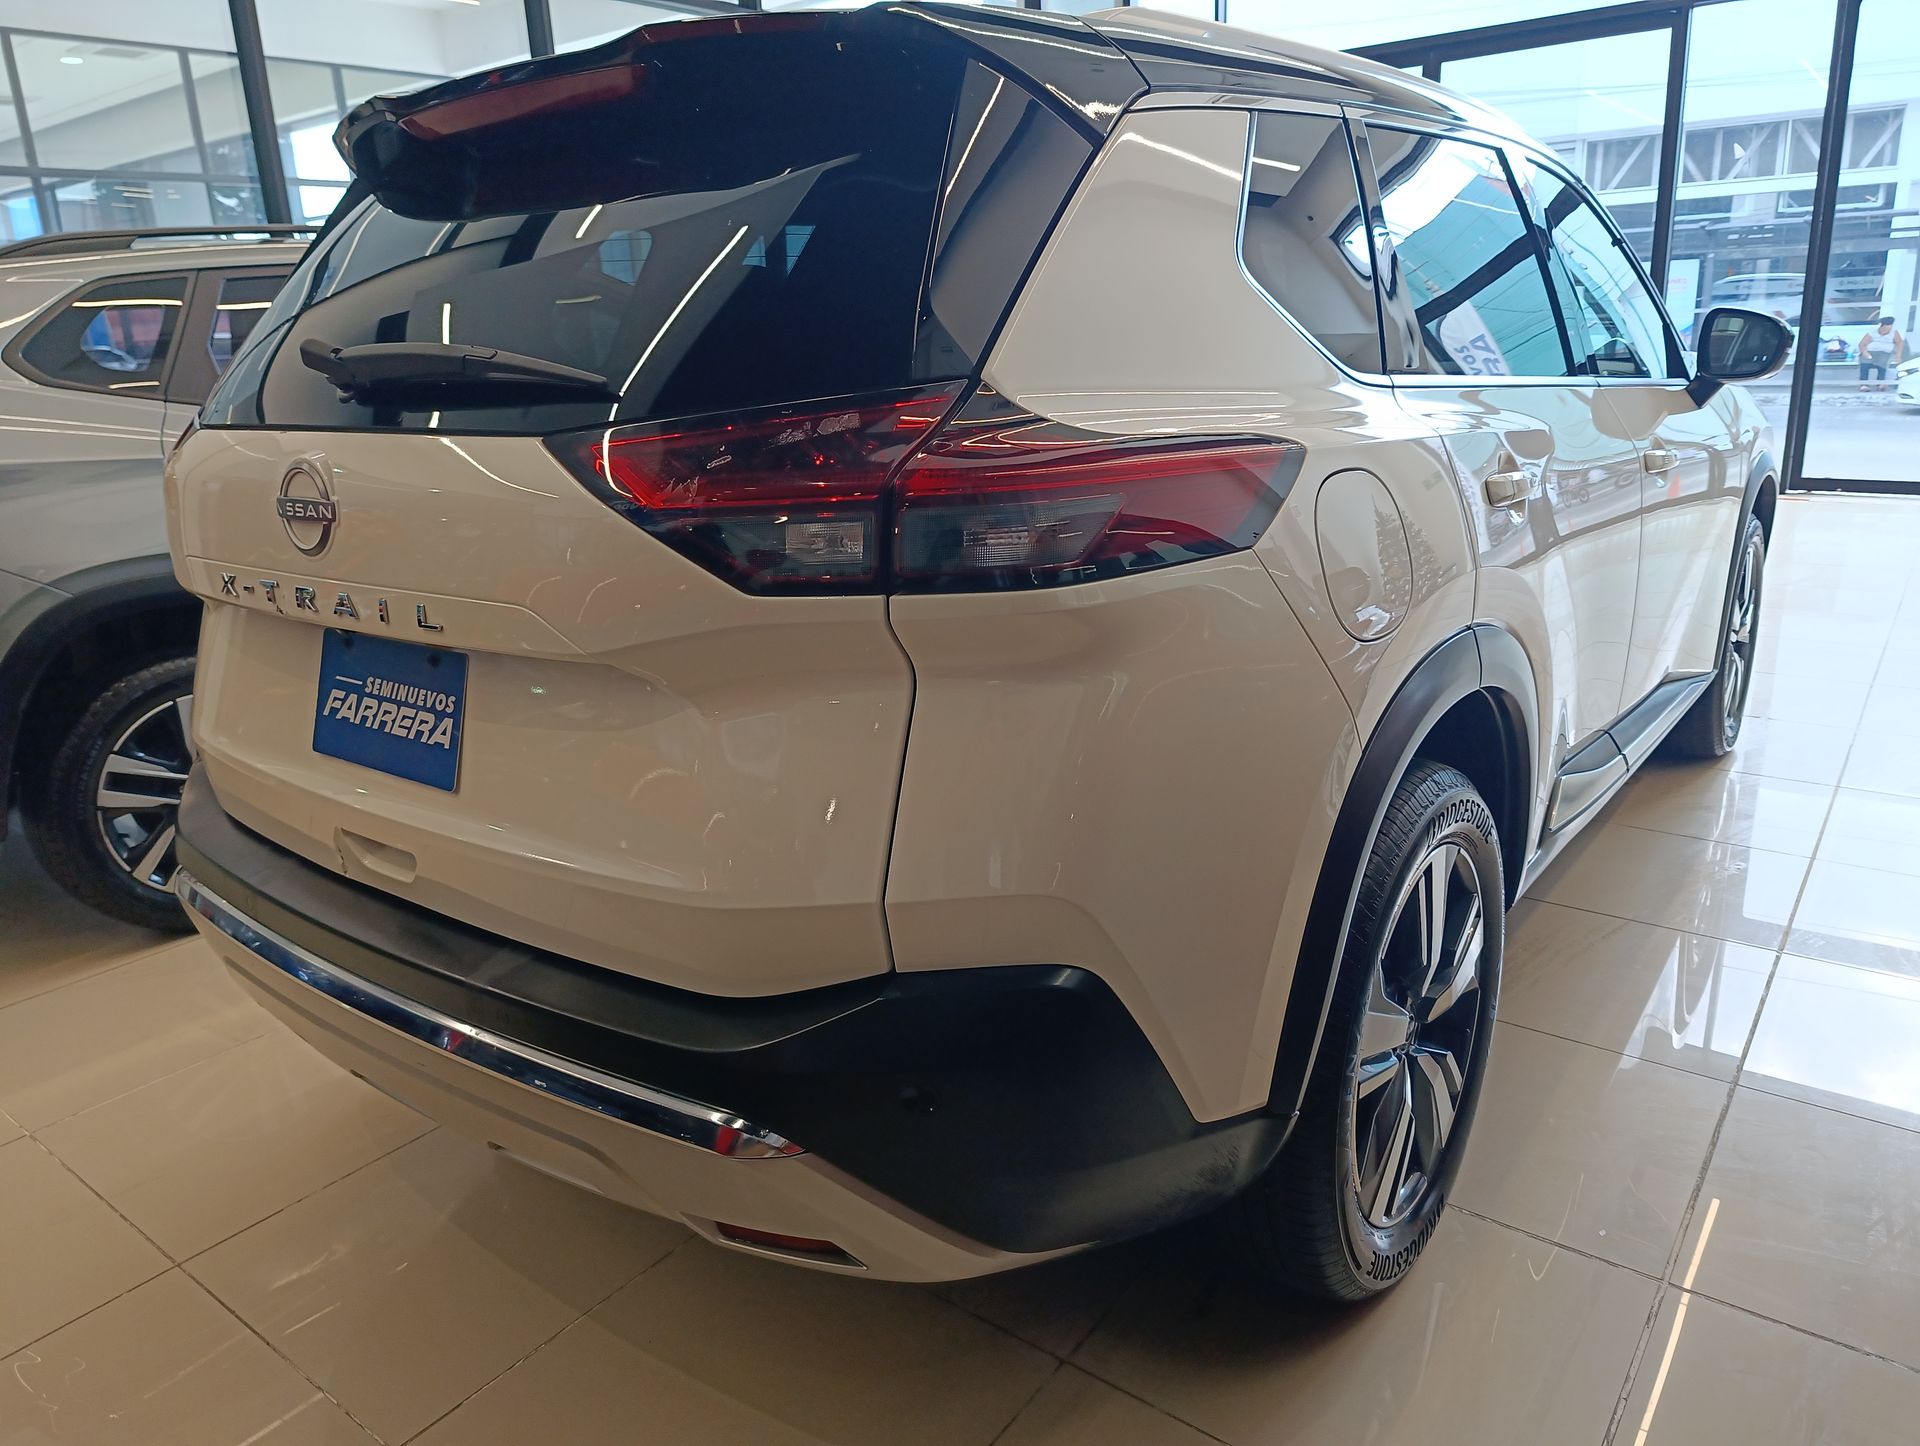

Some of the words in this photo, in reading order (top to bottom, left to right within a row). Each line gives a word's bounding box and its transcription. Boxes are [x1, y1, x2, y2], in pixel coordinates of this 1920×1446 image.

[221, 572, 444, 632] X-TRAIL
[323, 688, 455, 750] FARRERA
[364, 676, 457, 714] SEMINUEVOS
[1427, 798, 1496, 847] BRIDGESTONE
